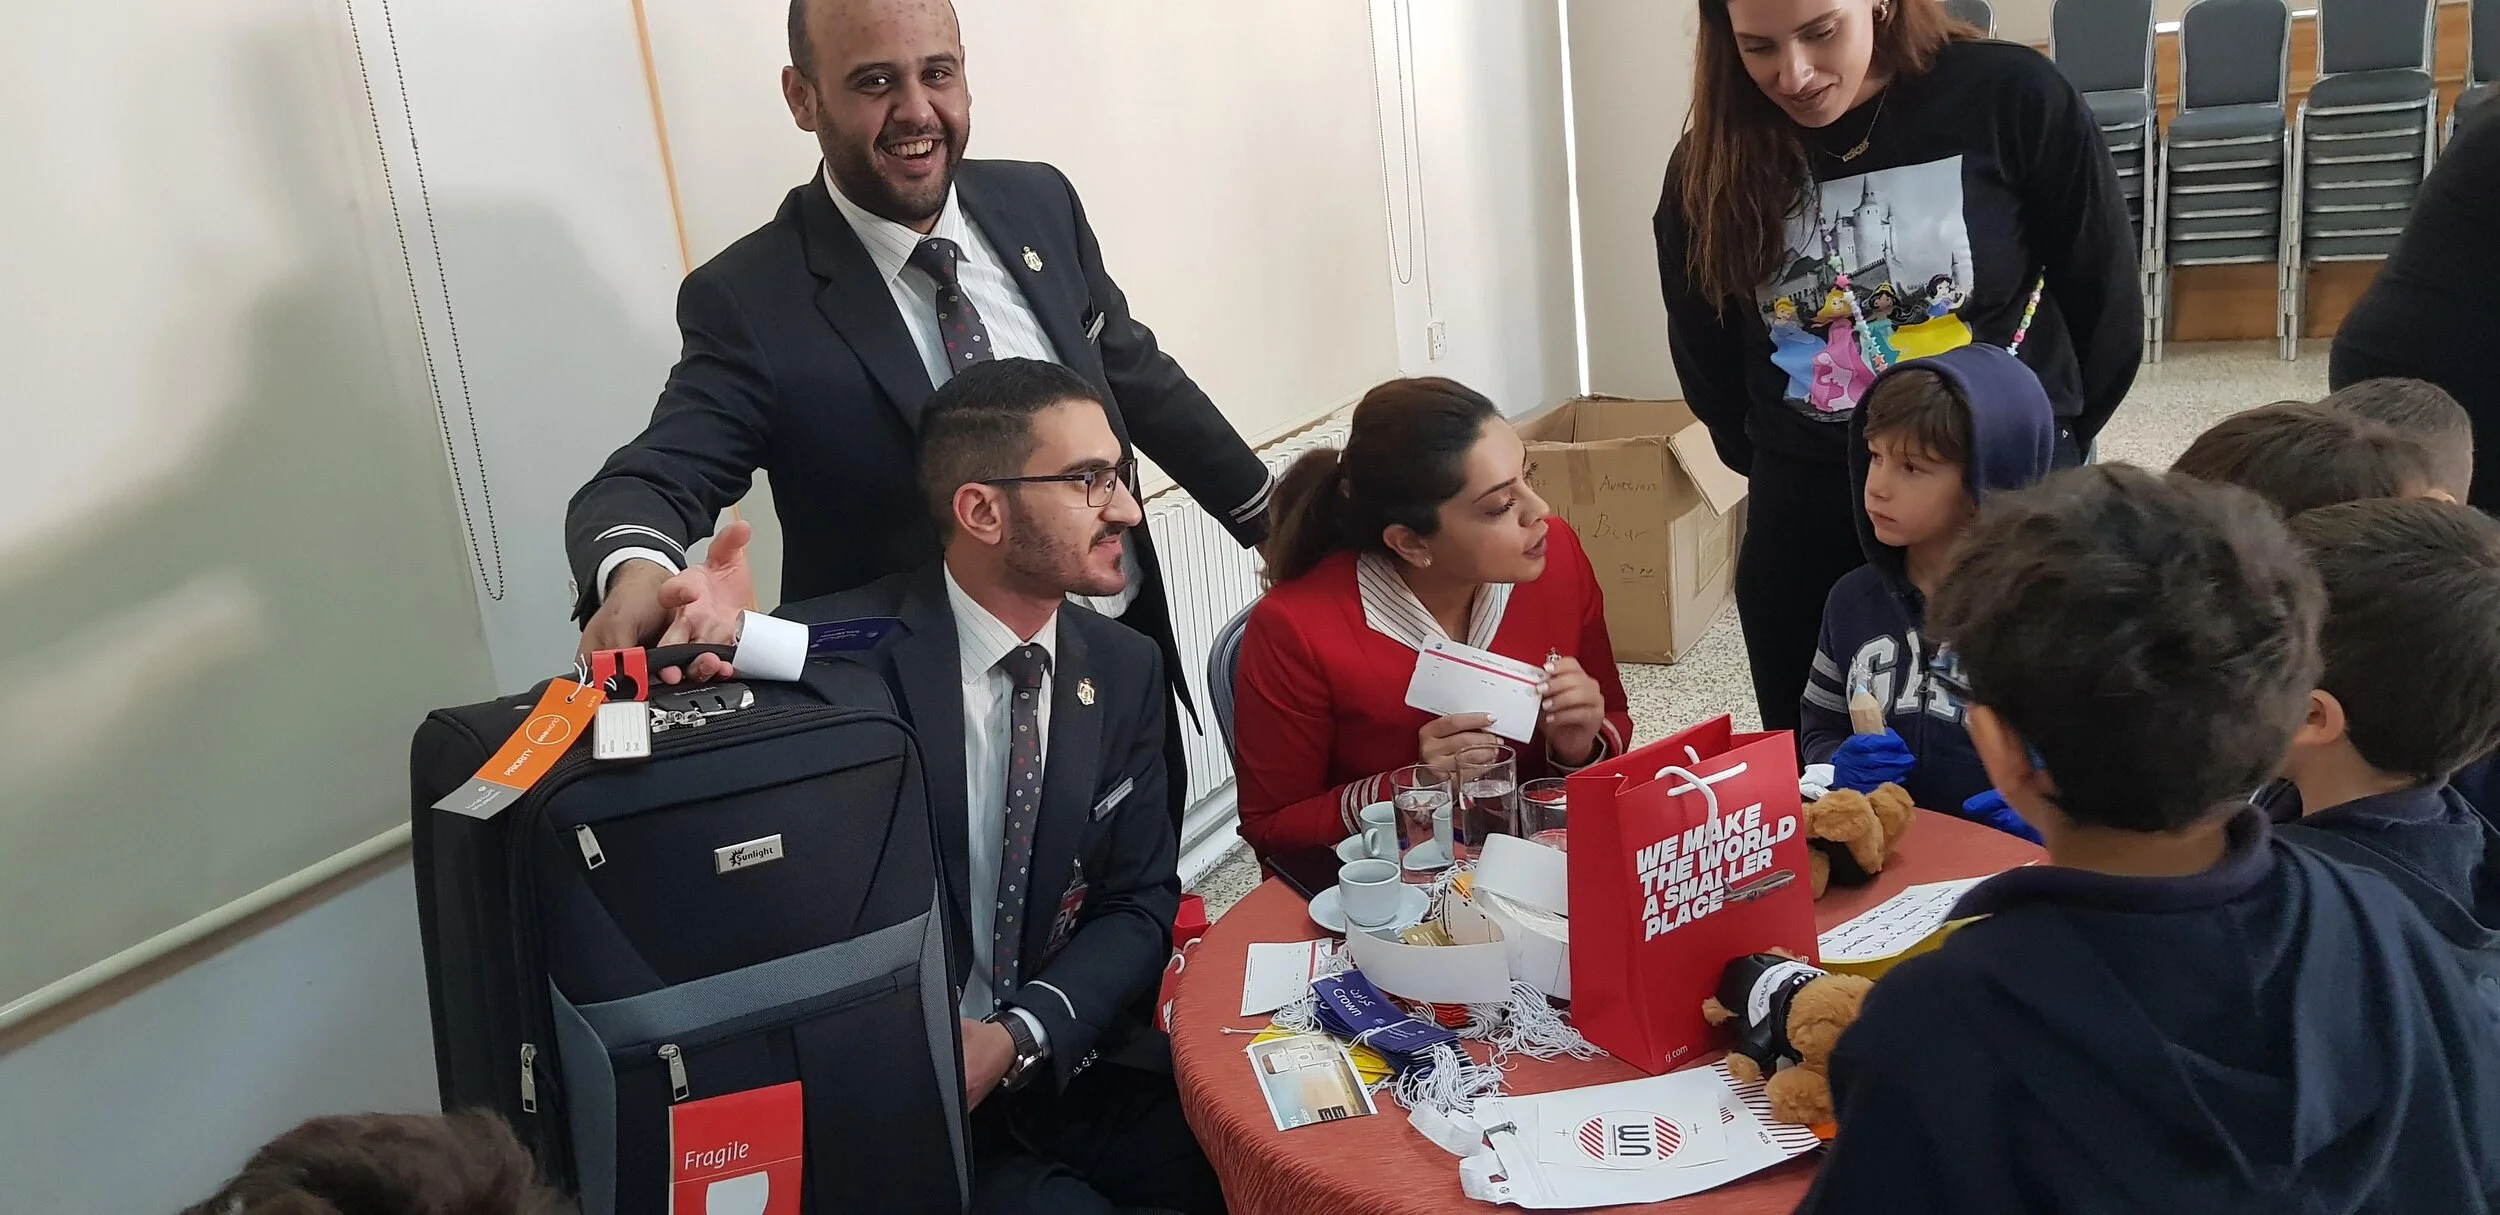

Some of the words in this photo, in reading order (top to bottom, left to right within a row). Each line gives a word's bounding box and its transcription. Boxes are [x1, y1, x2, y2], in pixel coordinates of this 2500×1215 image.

[1849, 627, 1969, 726] GA
[504, 748, 534, 776] PRIORITY
[735, 847, 774, 862] Sunlight
[1636, 834, 1679, 875] WE
[1682, 802, 1762, 856] MAKE
[1639, 853, 1694, 897] THE
[1699, 815, 1797, 874] WORLD
[1642, 894, 1659, 921] A
[1663, 847, 1773, 910] SMALLER
[1645, 887, 1725, 942] PLACE
[1333, 988, 1362, 1017] Crown
[1665, 1045, 1689, 1063] rj.com
[684, 1141, 750, 1170] Fragile
